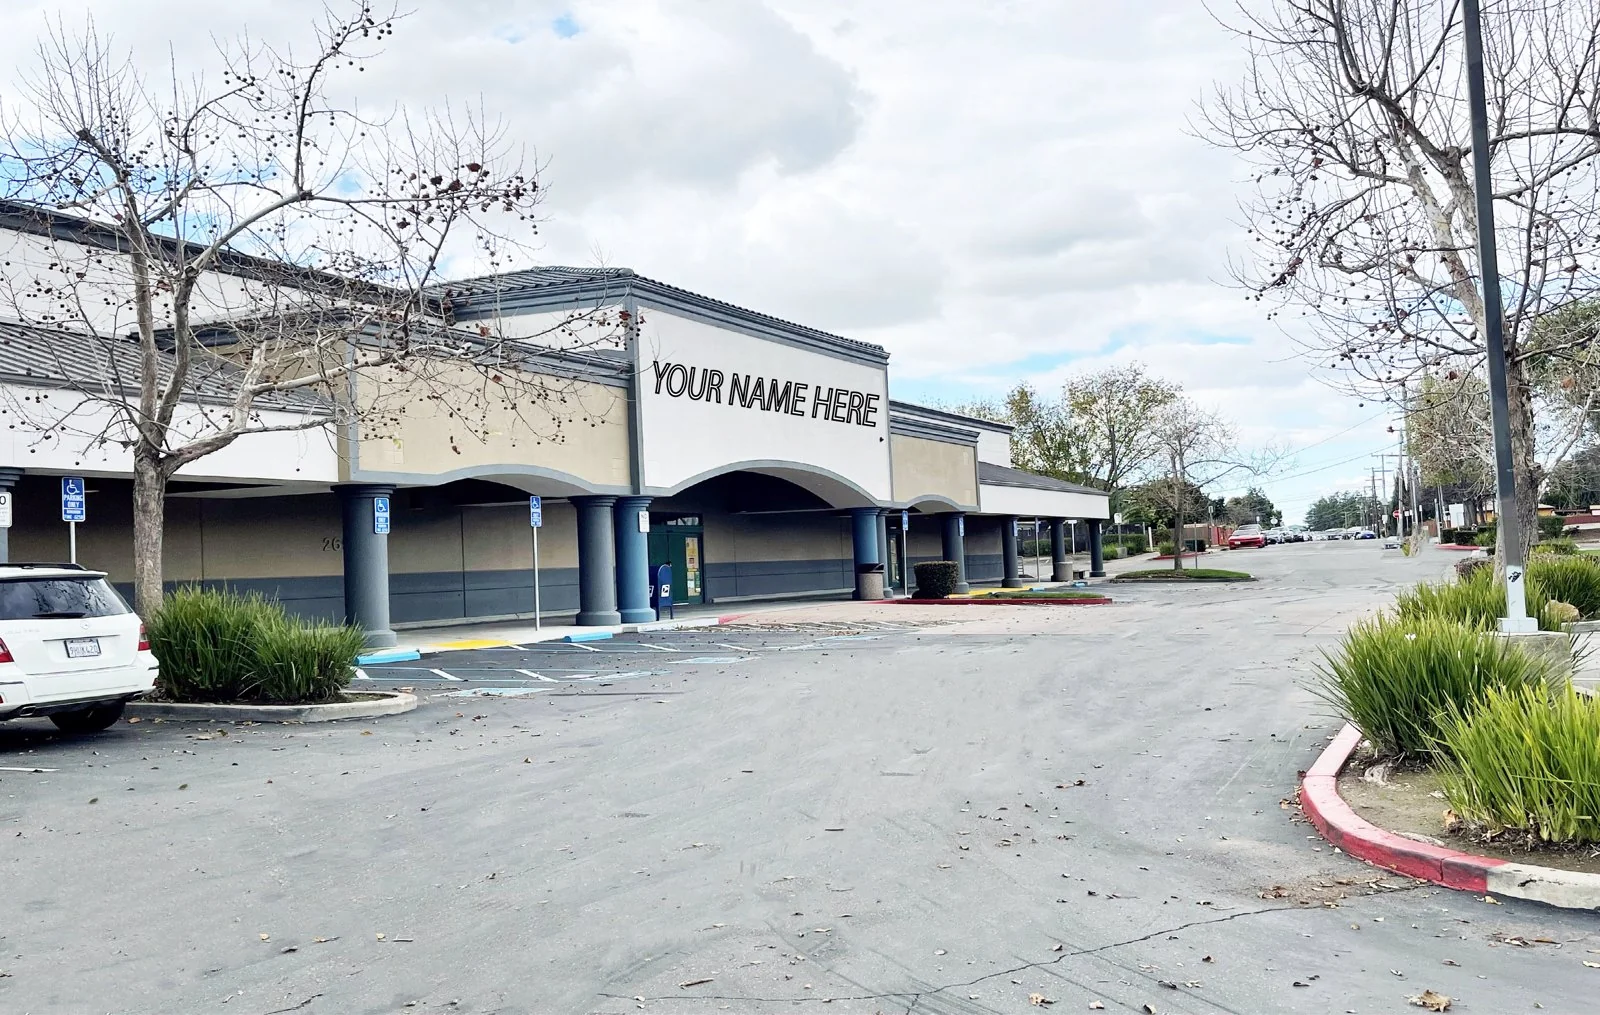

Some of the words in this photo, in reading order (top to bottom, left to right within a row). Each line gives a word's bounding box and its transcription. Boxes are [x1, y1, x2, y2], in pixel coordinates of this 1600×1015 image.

[653, 361, 724, 403] YOUR
[728, 373, 808, 416] NAME
[812, 386, 880, 427] HERE
